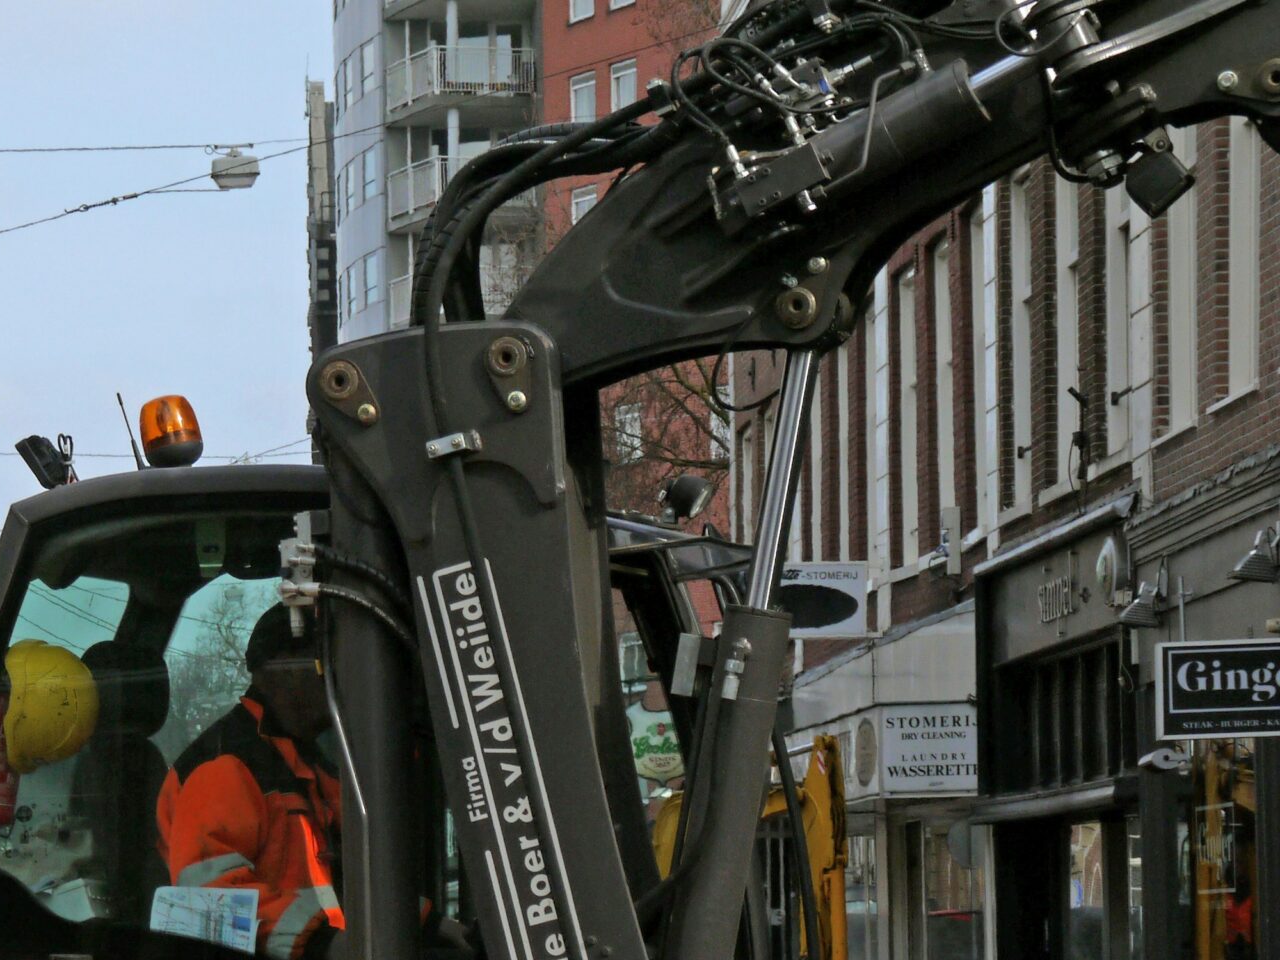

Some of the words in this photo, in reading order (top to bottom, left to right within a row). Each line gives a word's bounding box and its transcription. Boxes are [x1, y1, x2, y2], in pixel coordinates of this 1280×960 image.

[1177, 659, 1280, 701] Ging
[901, 732, 919, 741] DRY
[921, 731, 967, 740] CLEANING
[1183, 721, 1214, 729] STEAK
[1220, 719, 1260, 728] BURGER
[902, 753, 967, 762] LAUNDRY
[461, 757, 489, 822] Firma
[503, 796, 533, 823] &
[518, 835, 558, 926] Boer
